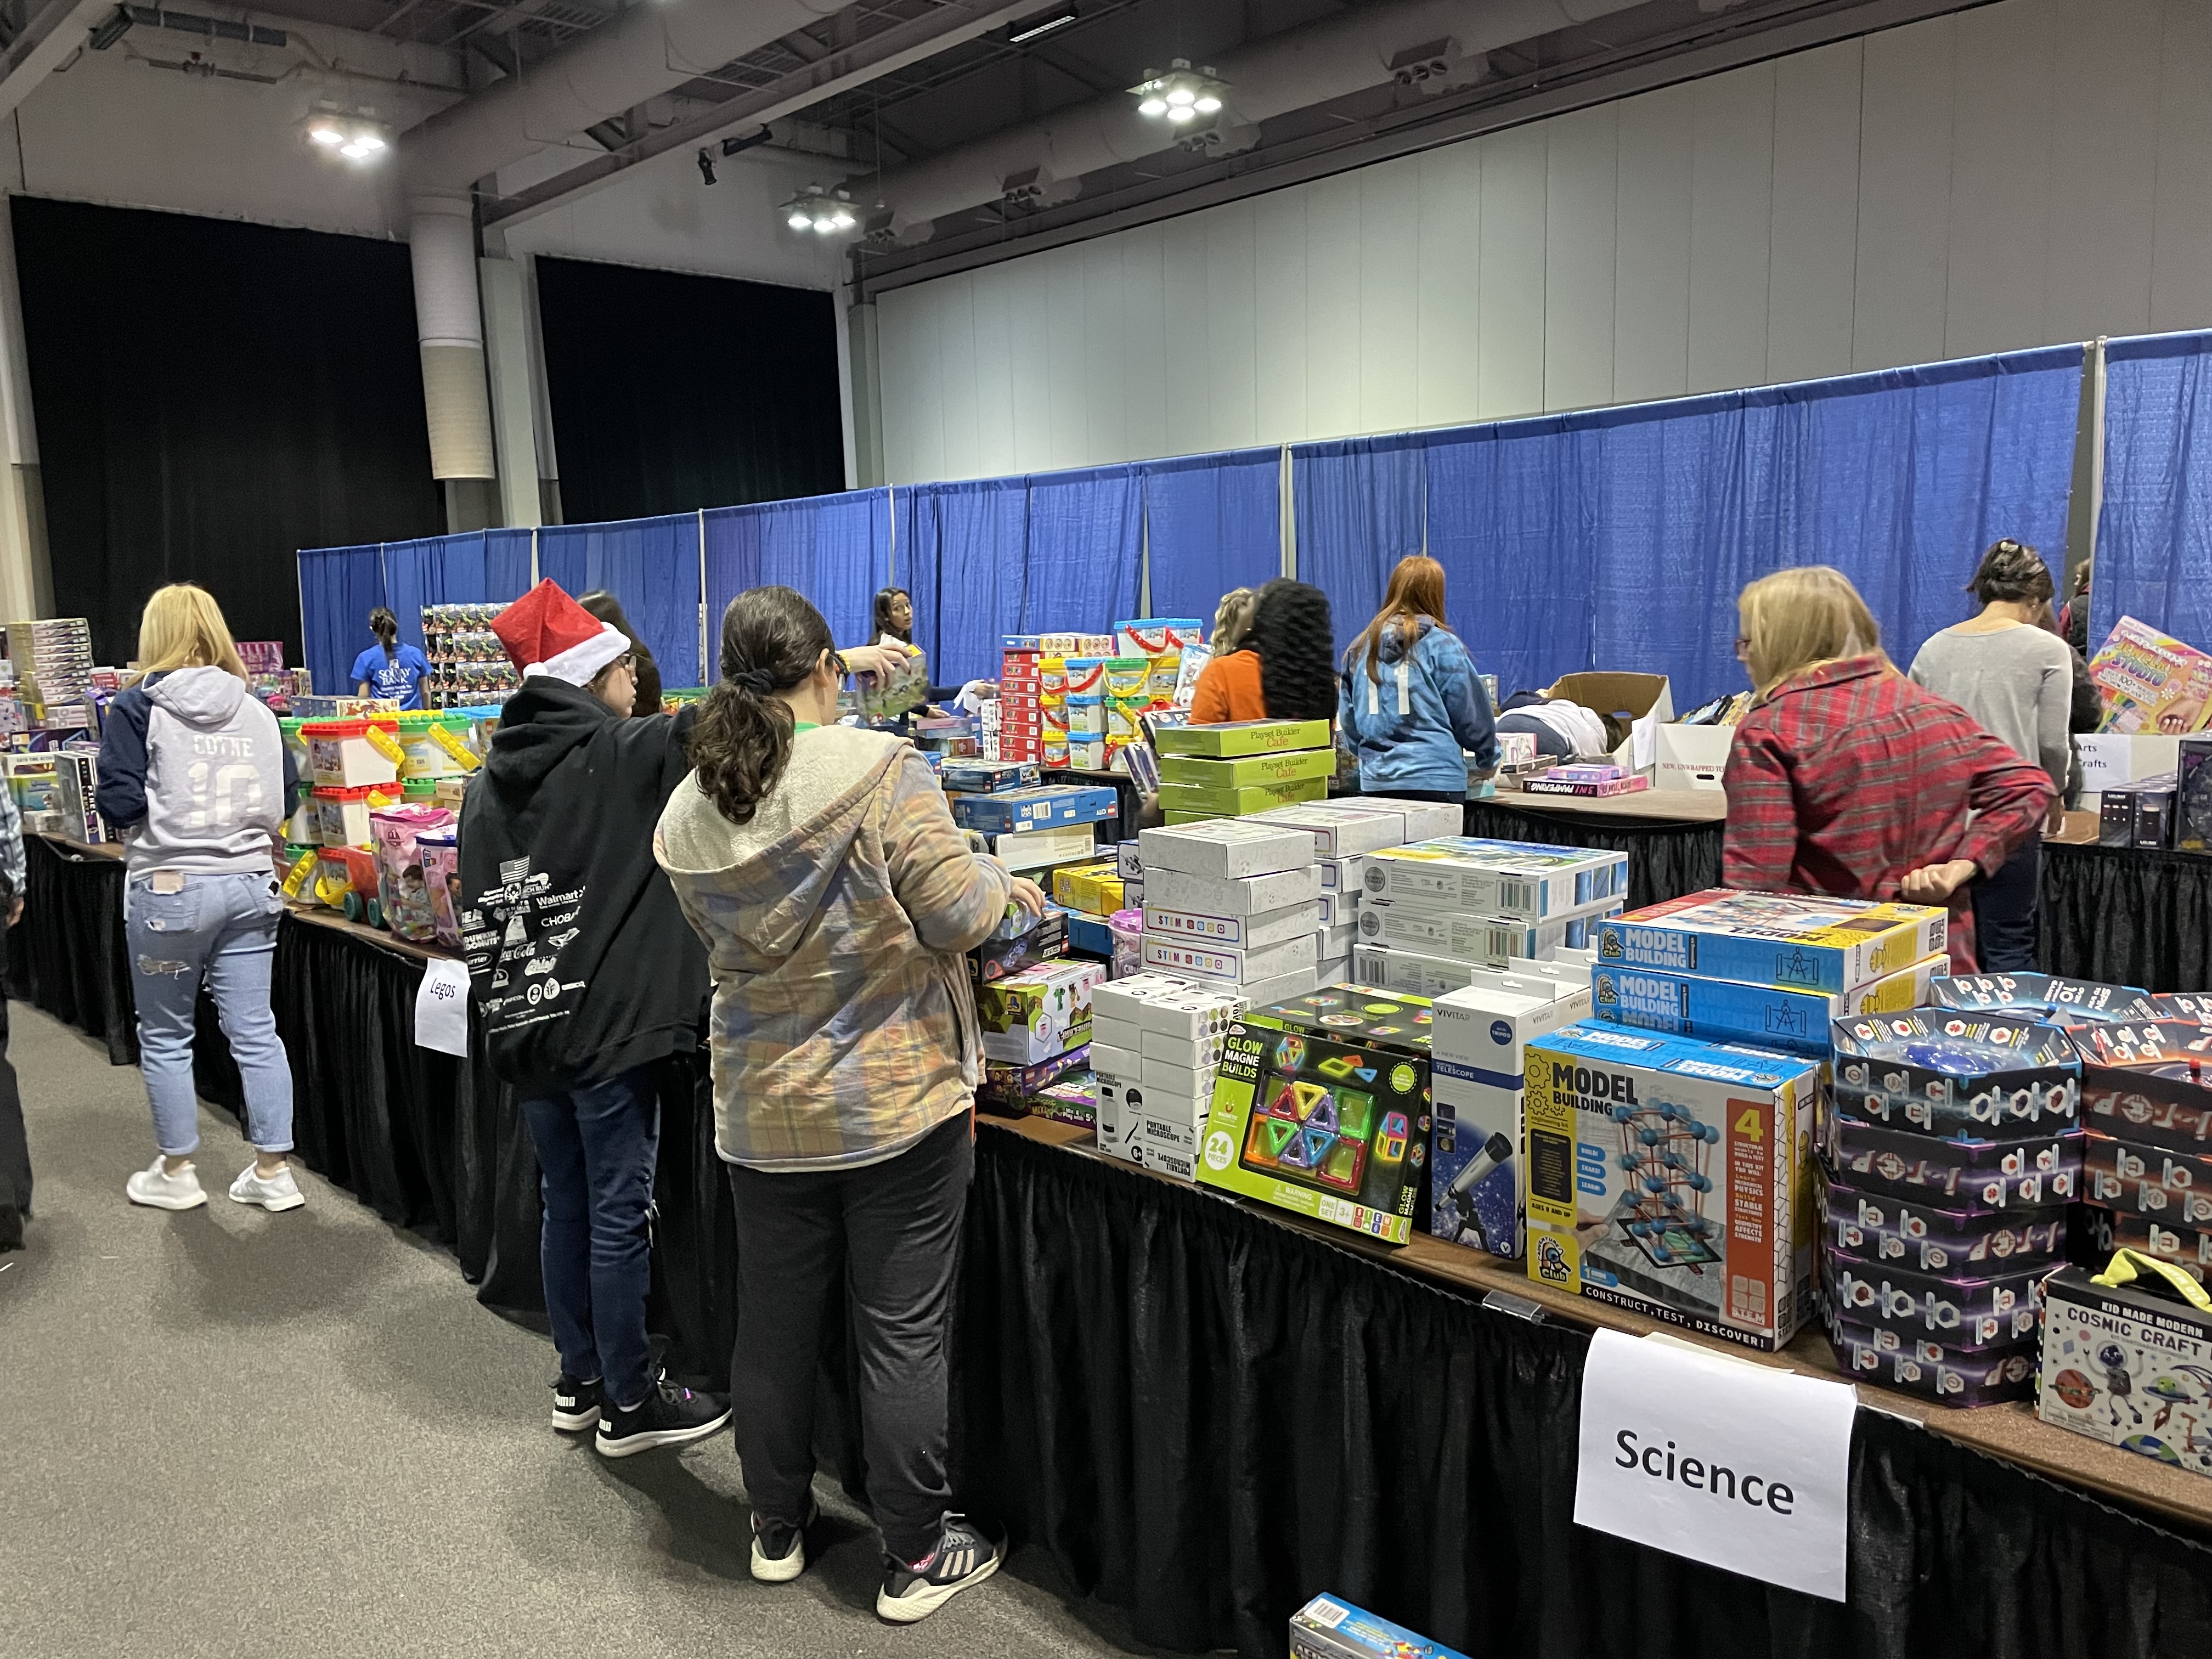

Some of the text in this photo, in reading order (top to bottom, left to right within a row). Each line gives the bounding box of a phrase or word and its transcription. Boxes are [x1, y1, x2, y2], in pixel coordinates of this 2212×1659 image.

[2111, 652, 2166, 687] STUDIO
[1251, 727, 1301, 740] Playset Builder
[1266, 736, 1289, 748] Cafe
[1261, 758, 1308, 771] Playset Builder
[1677, 763, 1714, 772] UNWRAPPED
[2079, 759, 2107, 768] rafts
[1276, 766, 1296, 778] Cafe
[188, 763, 262, 825] 10
[1266, 783, 1305, 796] Playset Builder
[1530, 782, 1575, 793] PAMPERING
[1277, 792, 1295, 804] Cafe
[536, 889, 579, 905] Walmart
[1159, 915, 1181, 927] STEM
[1626, 928, 1686, 953] MODEL
[1158, 950, 1180, 962] STEM
[1604, 949, 1621, 957] Club
[1626, 947, 1686, 968] BUILDING
[430, 977, 456, 1000] Legos
[1620, 975, 1678, 1003] MODEL
[1599, 996, 1616, 1004] Club
[1621, 995, 1679, 1017] BUILDING
[1437, 1009, 1470, 1022] VIVITAR
[1532, 1011, 1554, 1024] VIVITAR
[1284, 1023, 1305, 1034] GLOW
[1491, 1029, 1511, 1039] TRIPOD
[1227, 1036, 1263, 1056] GLOW
[1224, 1049, 1260, 1066] MAGNE
[1436, 1065, 1474, 1079] TELESCOPE
[1553, 1062, 1639, 1105] MODEL
[1553, 1090, 1613, 1116] BUILDING
[1146, 1120, 1171, 1133] PORTABLE
[1735, 1108, 1764, 1143] 4
[1147, 1127, 1180, 1143] MICROSCOPE
[1209, 1137, 1228, 1155] 24
[1158, 1153, 1190, 1169] MICROSCOPE
[1208, 1153, 1227, 1164] PIECES
[1285, 1186, 1314, 1201] WARNING:
[1735, 1184, 1763, 1197] PHYSICS
[1322, 1199, 1335, 1209] ONE
[1398, 1185, 1409, 1215] GLOW
[1735, 1199, 1763, 1211] STABLE
[1321, 1208, 1334, 1218] SET
[1339, 1207, 1350, 1218] 3+
[1532, 1203, 1544, 1211] AGES
[1551, 1207, 1562, 1216] AND
[1735, 1224, 1763, 1237] AFFECTS
[1542, 1268, 1567, 1280] Club
[1584, 1268, 1590, 1279] 1
[2102, 1301, 2203, 1338] KID MADE MODERN
[1696, 1320, 1764, 1348] DISCOVER!
[2067, 1307, 2202, 1356] COSMIC CRAFT
[1615, 1427, 1796, 1517] Science
